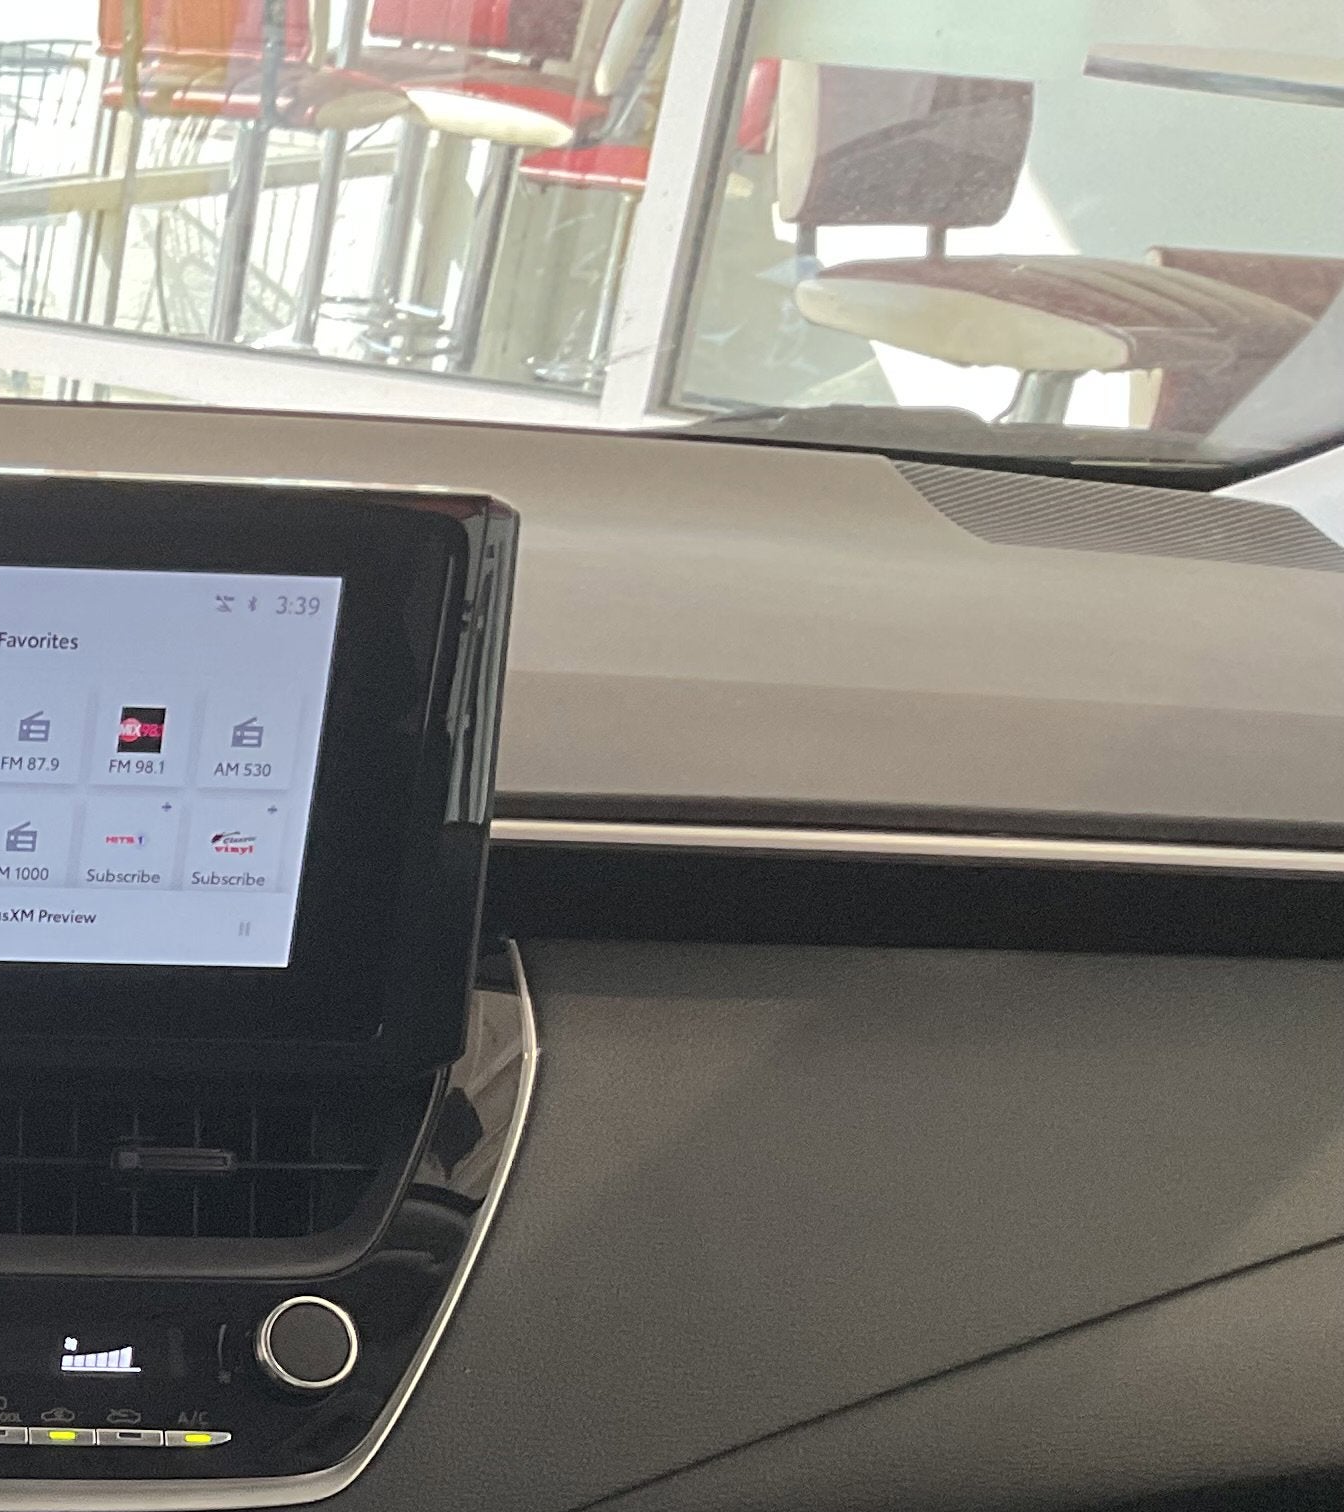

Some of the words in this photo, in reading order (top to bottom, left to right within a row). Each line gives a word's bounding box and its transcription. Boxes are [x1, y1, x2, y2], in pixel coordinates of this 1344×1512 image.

[276, 597, 321, 615] 3:39
[0, 757, 23, 771] FM
[26, 757, 60, 772] 87.9
[109, 759, 132, 774] FM
[135, 760, 165, 775] 98.1
[214, 762, 240, 777] AM
[242, 763, 272, 777] 530
[15, 867, 49, 882] 1000
[86, 869, 161, 884] Subscribe
[191, 871, 266, 887] Subscribe
[38, 909, 97, 925] Preview
[177, 1411, 209, 1426] A/C
